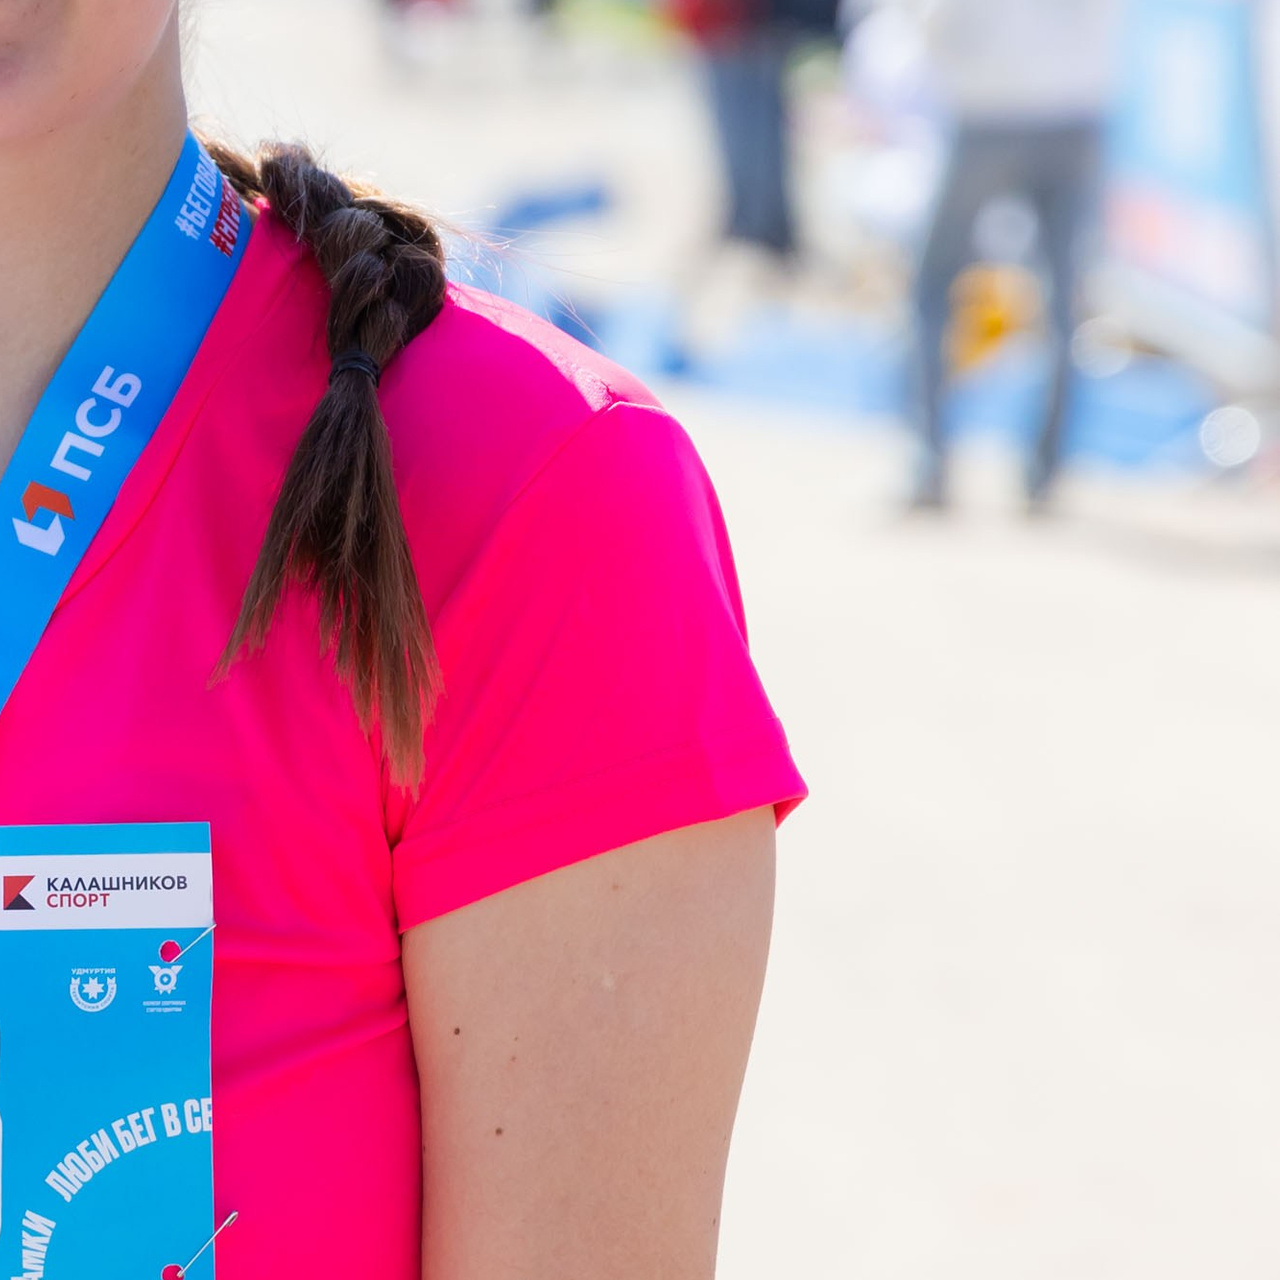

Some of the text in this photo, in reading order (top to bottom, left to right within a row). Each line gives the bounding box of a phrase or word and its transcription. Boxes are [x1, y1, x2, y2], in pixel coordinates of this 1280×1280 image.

[49, 365, 142, 482] ПСБ
[47, 875, 188, 891] КАЛАШНИКОВ
[46, 893, 111, 908] СПОРТ
[71, 967, 116, 975] УДМУРТИЯ
[45, 1128, 120, 1203] ЛЮБИ
[111, 1107, 157, 1154] БЕГ
[160, 1102, 182, 1138] В
